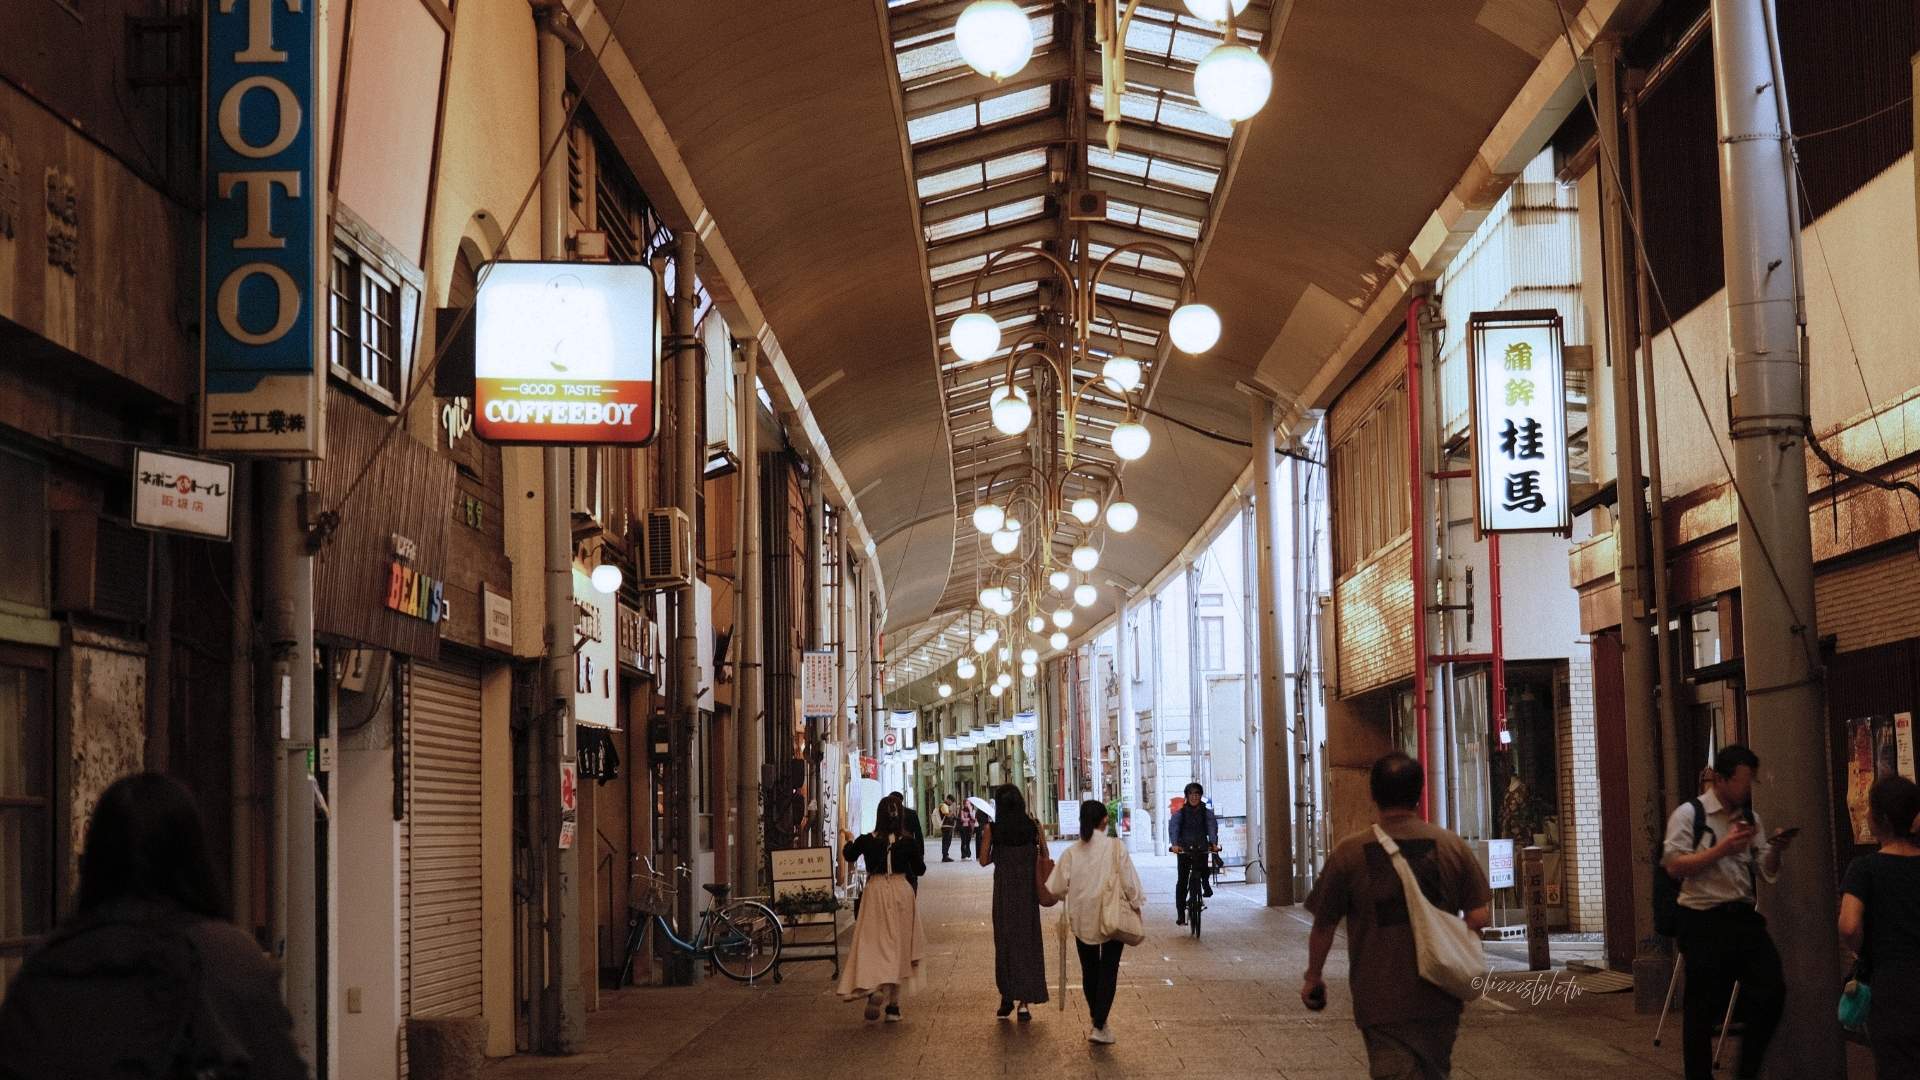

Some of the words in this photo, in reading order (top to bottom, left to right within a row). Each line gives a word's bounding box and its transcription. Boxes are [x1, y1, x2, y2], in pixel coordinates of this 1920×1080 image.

[217, 0, 302, 345] TOTO
[485, 400, 638, 425] COFFEEBOY
[519, 383, 556, 395] GOOD
[562, 384, 601, 396] TASTE
[1499, 417, 1547, 513] 桂馬
[387, 560, 444, 624] BEANS
